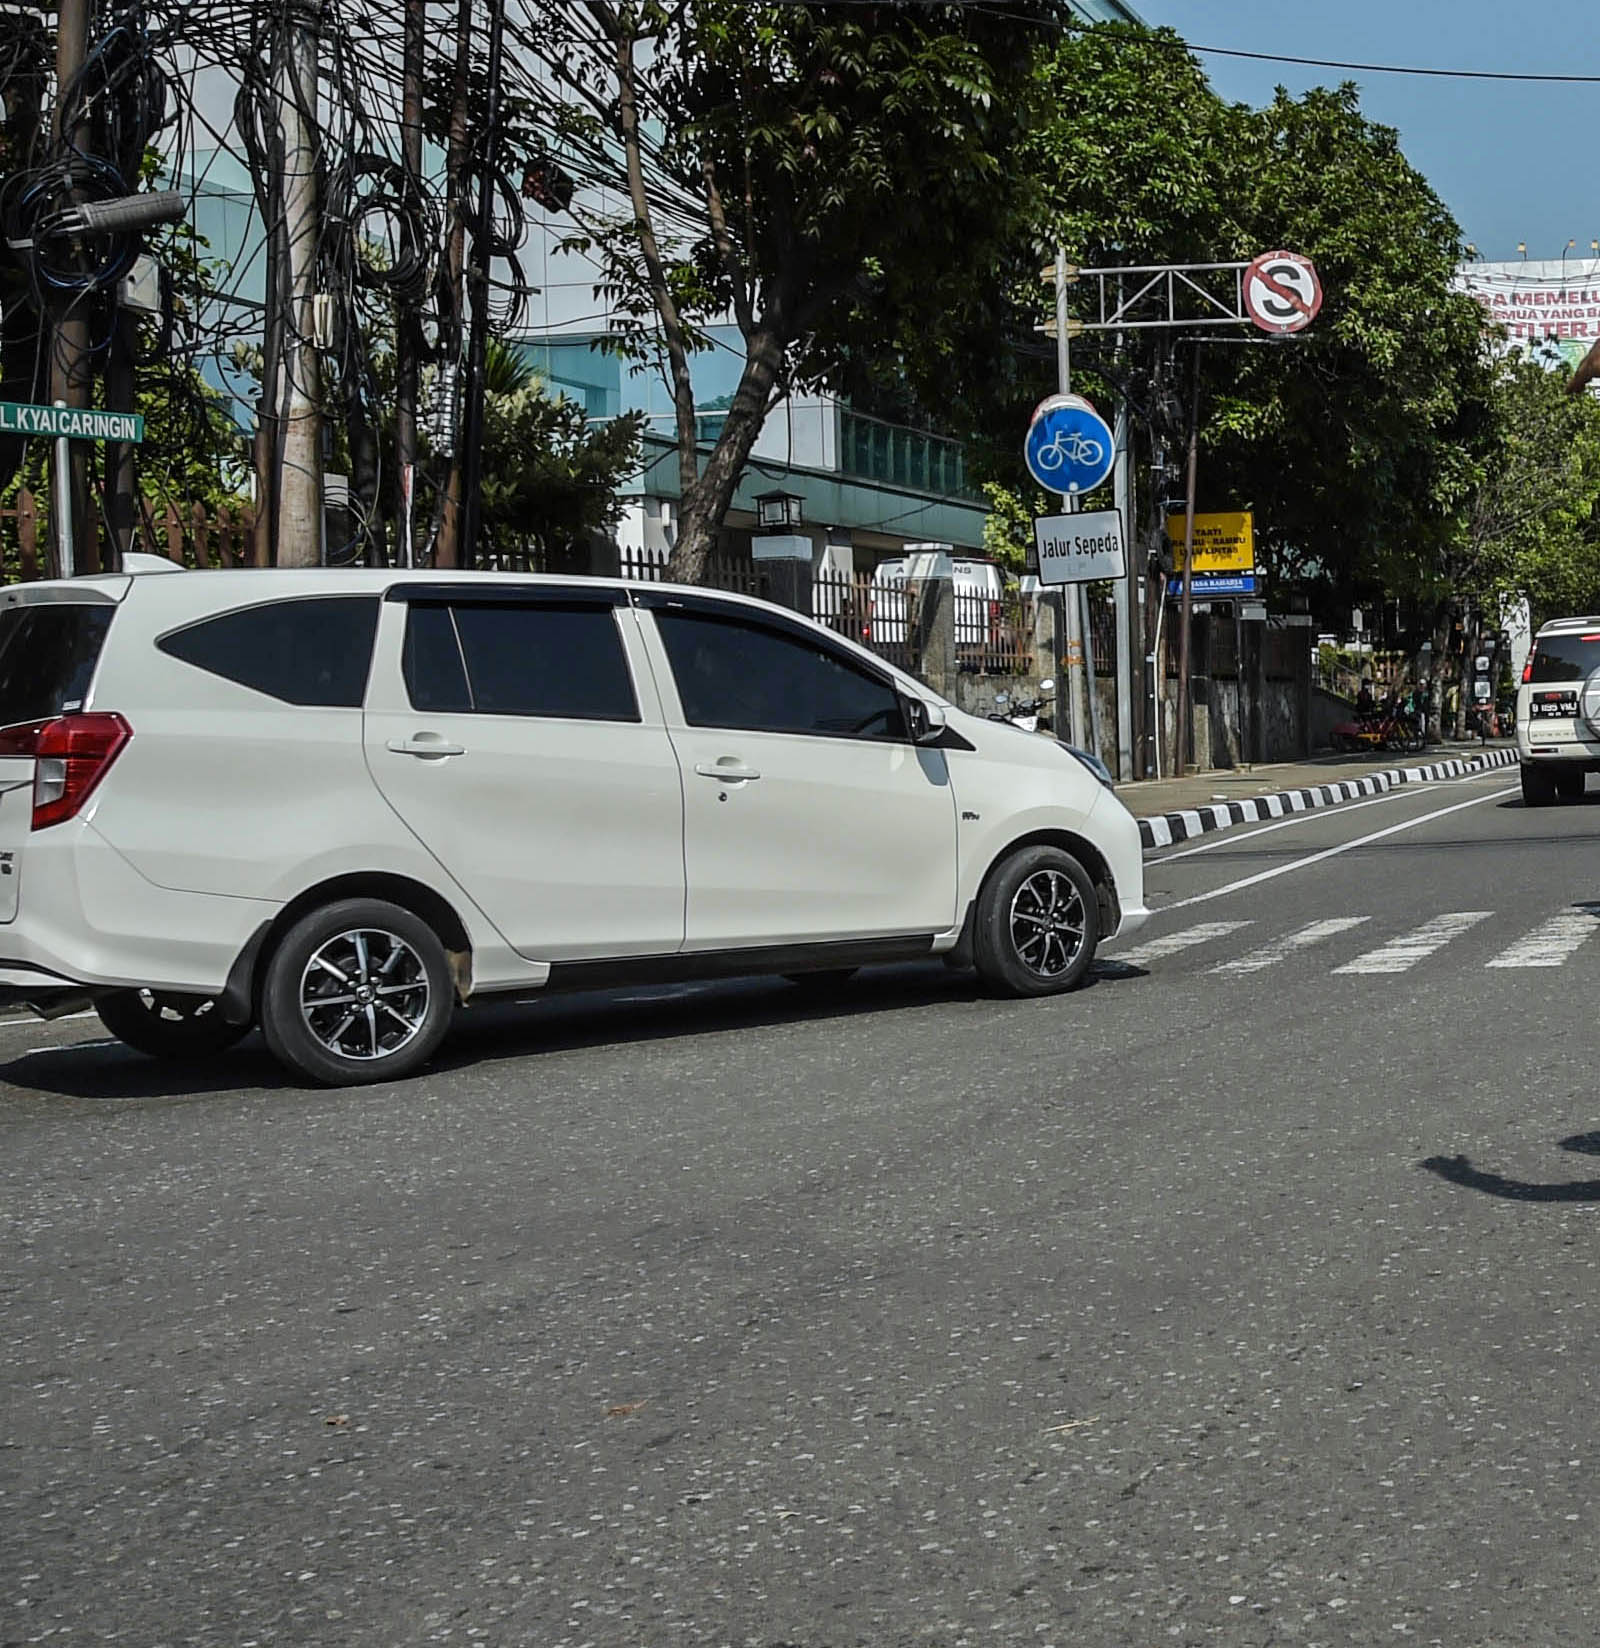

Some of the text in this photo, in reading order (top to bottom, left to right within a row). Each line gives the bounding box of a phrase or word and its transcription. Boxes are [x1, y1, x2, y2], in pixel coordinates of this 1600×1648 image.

[1540, 308, 1585, 319] YANG
[16, 407, 57, 433] KYAI
[59, 411, 136, 440] CARINGIN
[1042, 531, 1119, 559] Jalur Sepeda
